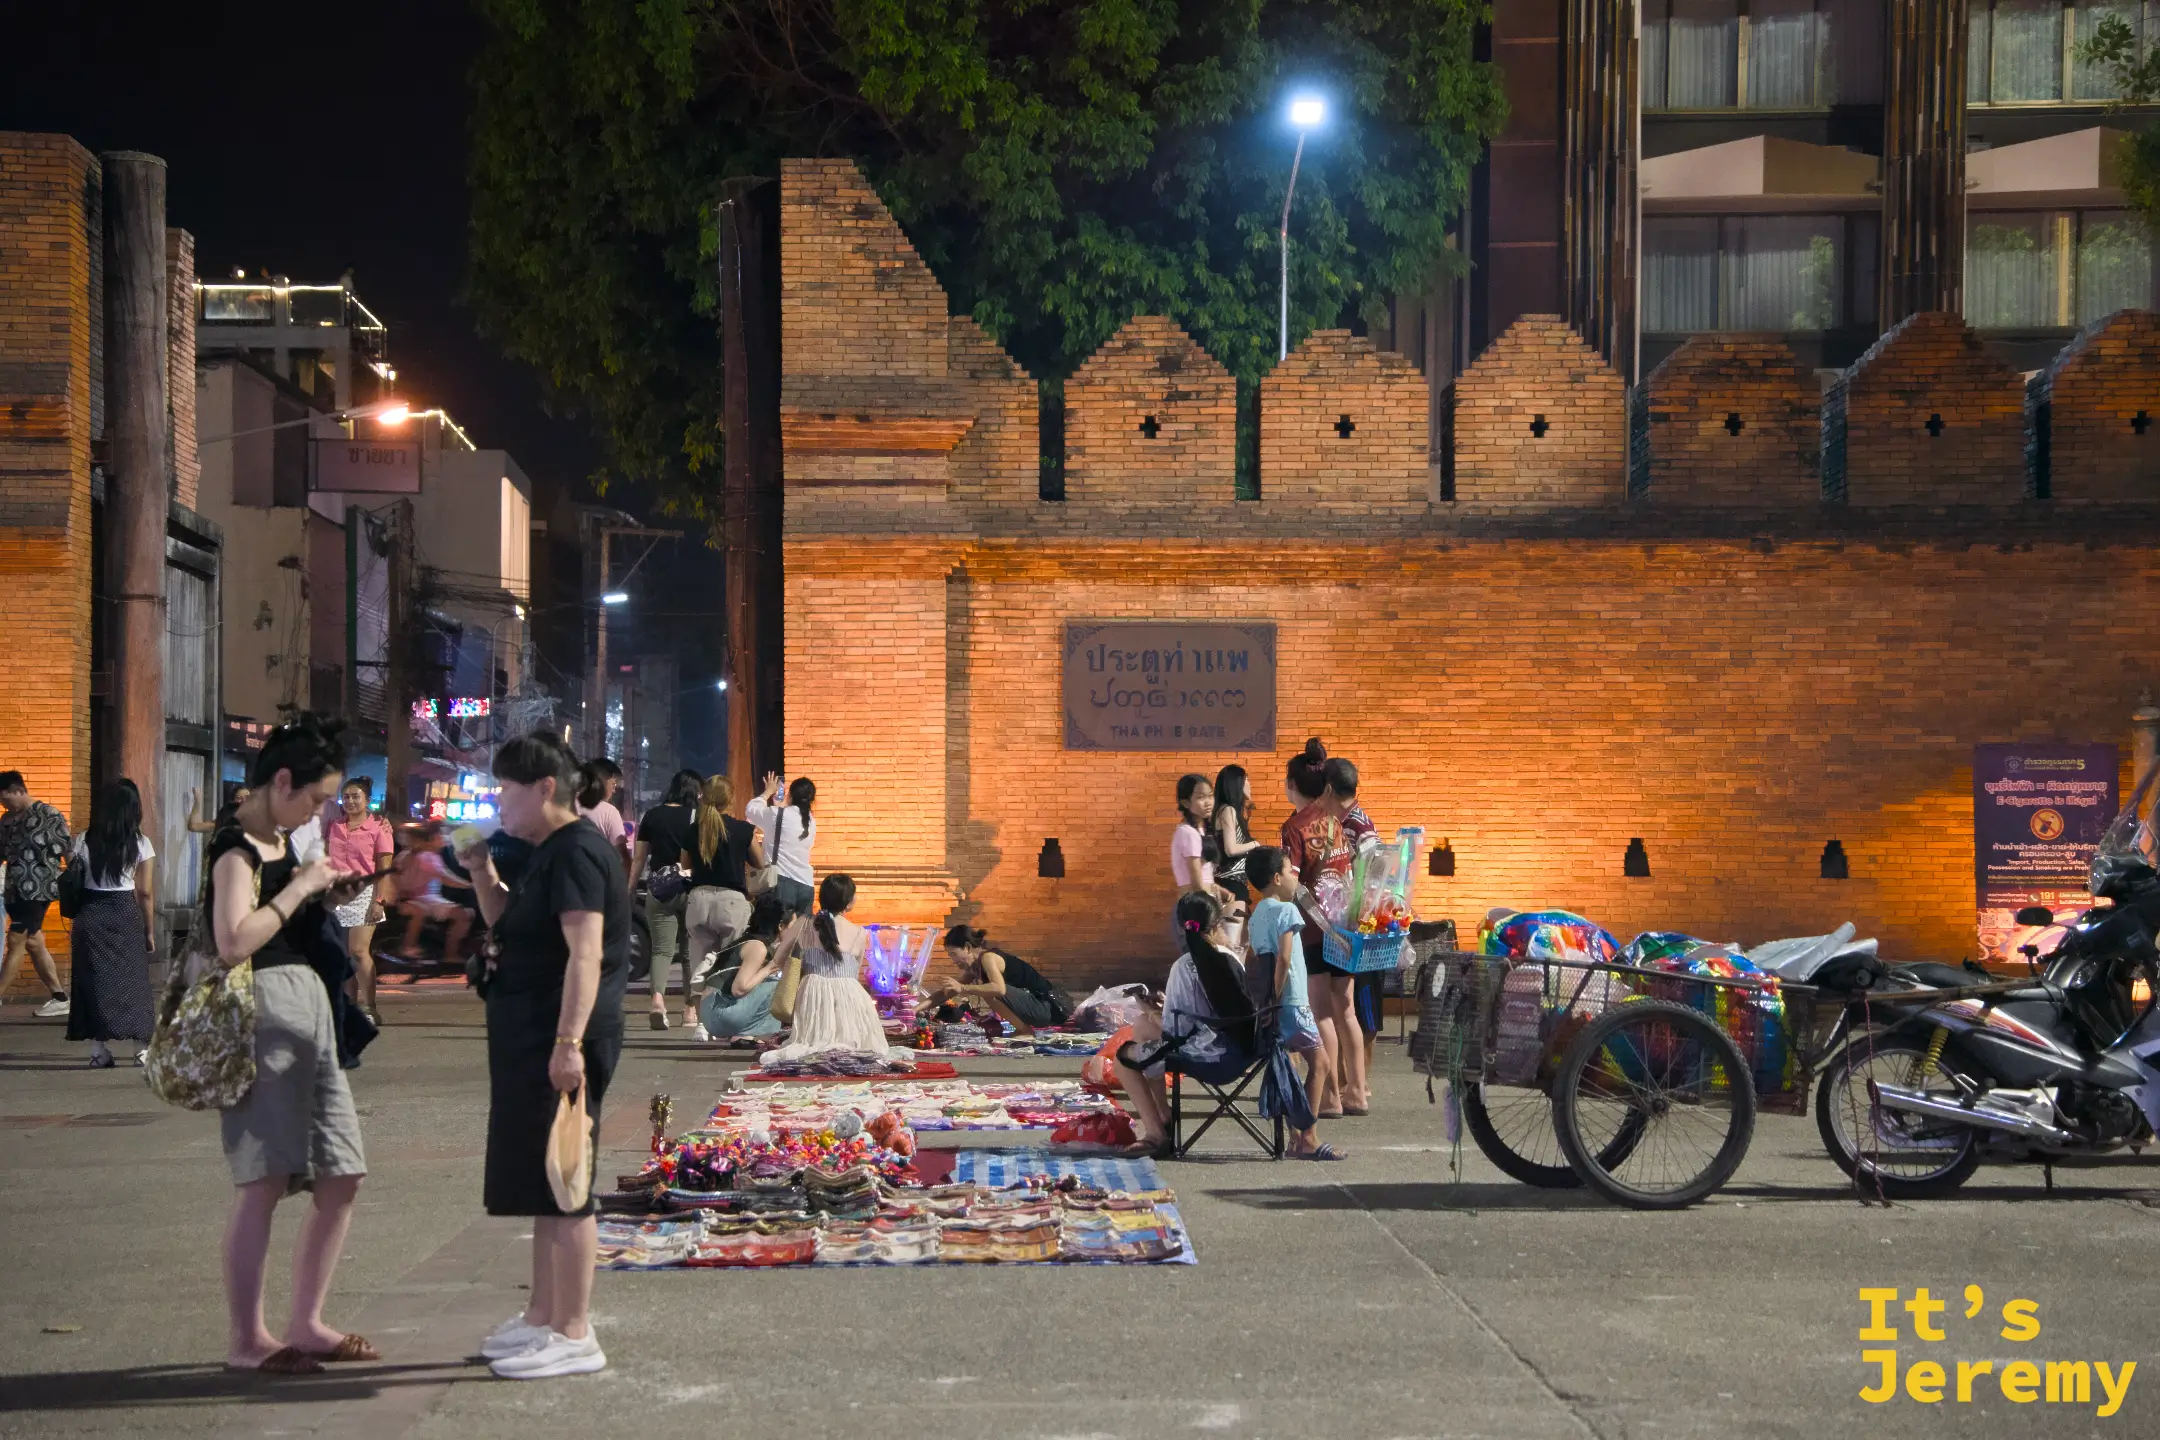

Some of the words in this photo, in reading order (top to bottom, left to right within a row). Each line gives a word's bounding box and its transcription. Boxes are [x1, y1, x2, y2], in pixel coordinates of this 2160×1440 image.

[1086, 640, 1249, 685] ประตูท่าแพ
[1109, 724, 1139, 738] THA
[1144, 725, 1182, 738] PHE
[1188, 725, 1226, 738] GATE
[2076, 758, 2085, 770] 5
[1996, 796, 2053, 807] E-Cigarette
[2055, 796, 2064, 805] is
[2040, 891, 2054, 899] 191
